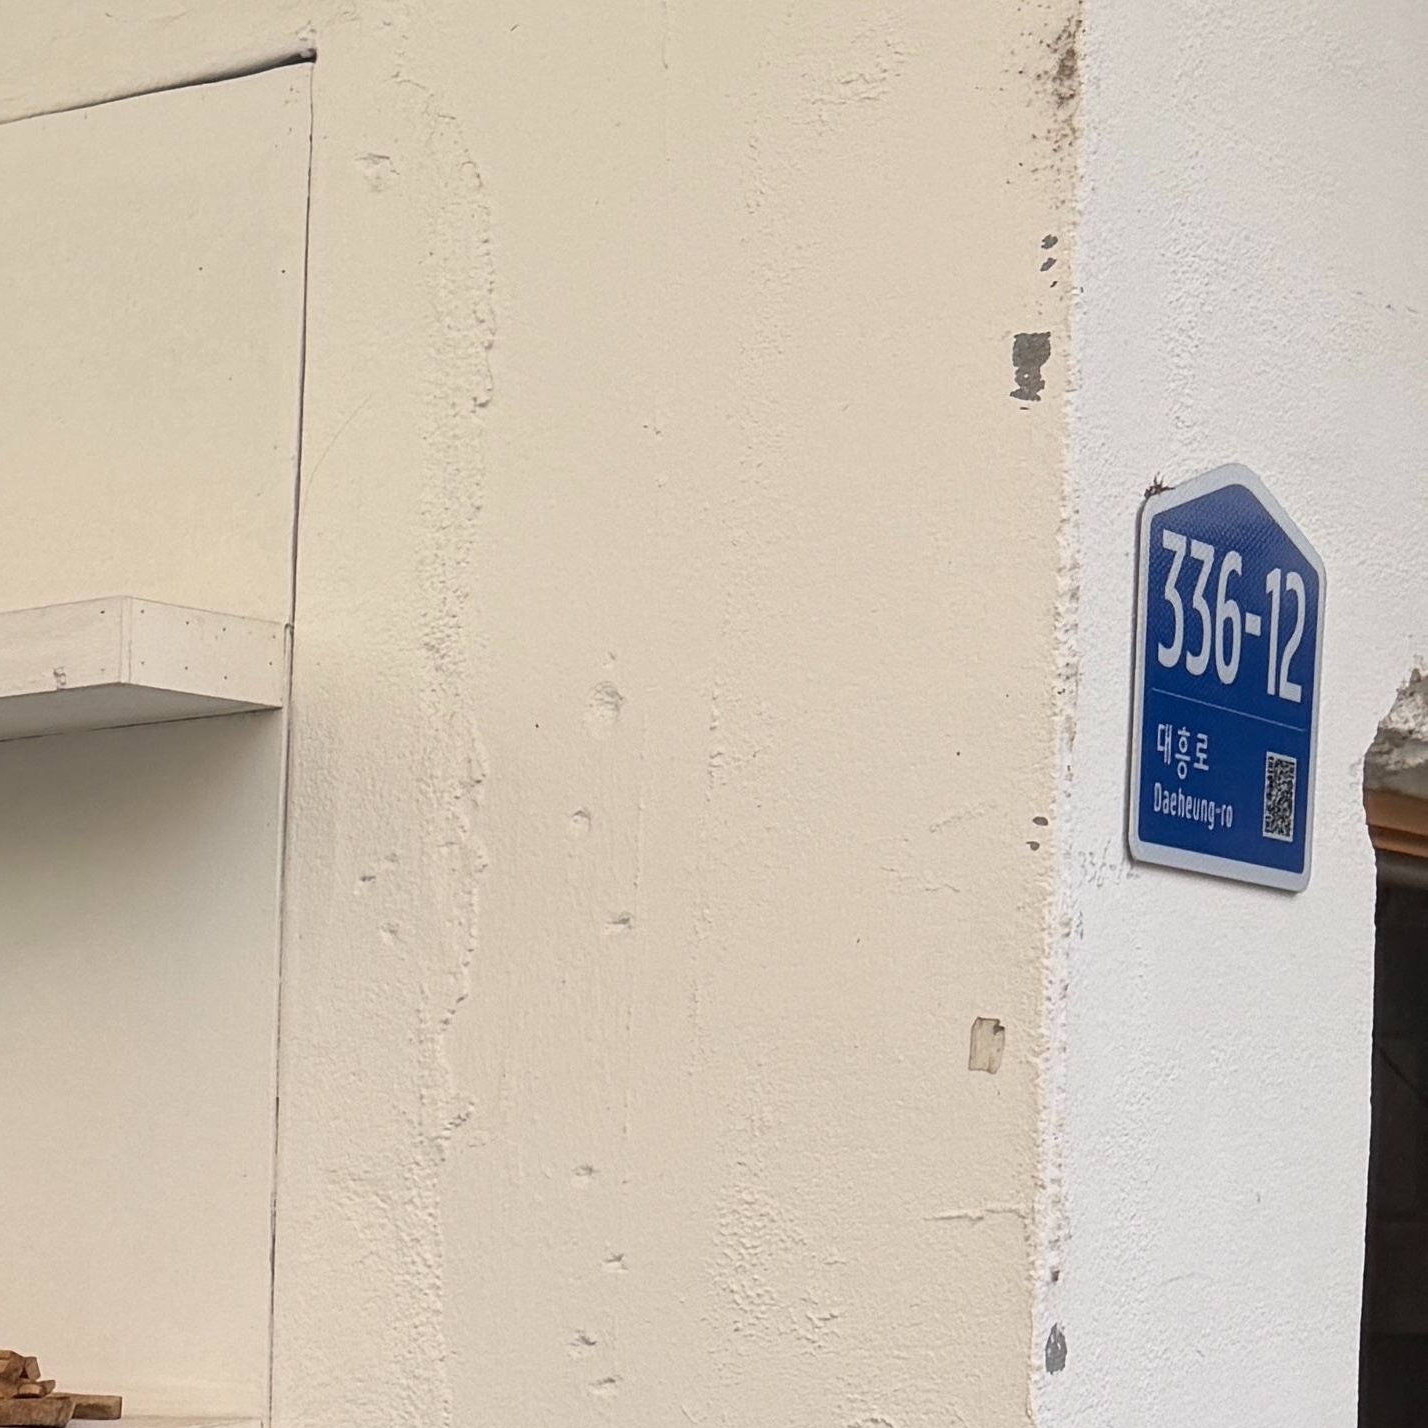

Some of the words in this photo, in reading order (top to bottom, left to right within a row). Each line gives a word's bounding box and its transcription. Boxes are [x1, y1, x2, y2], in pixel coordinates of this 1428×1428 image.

[1158, 529, 1307, 704] 336-12
[1157, 723, 1210, 780] 대흥로
[1153, 782, 1234, 830] Daeheung-ro
